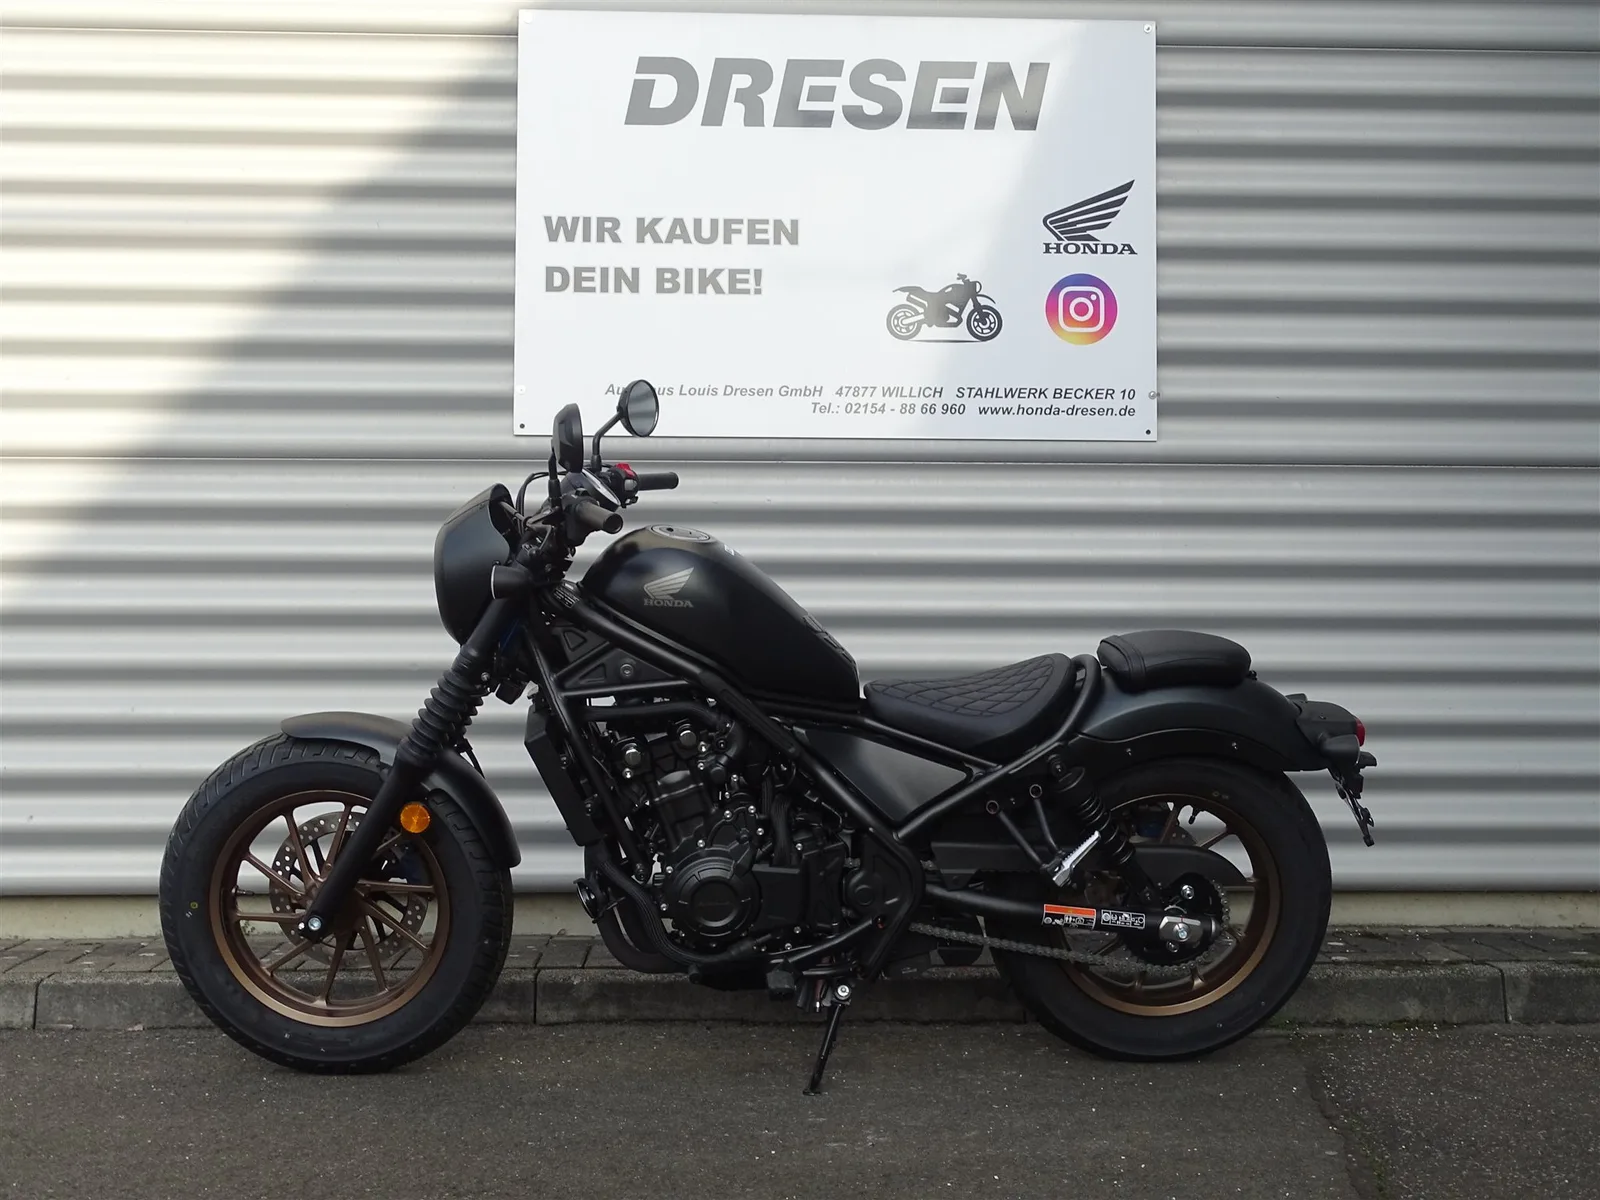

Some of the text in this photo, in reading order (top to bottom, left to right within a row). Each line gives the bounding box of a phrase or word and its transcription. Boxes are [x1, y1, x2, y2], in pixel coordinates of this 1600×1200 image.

[624, 56, 1050, 131] DRESEN
[544, 216, 799, 246] WIR KAUFEN
[1043, 242, 1138, 255] HONDA
[544, 266, 763, 295] DEIN BIKE!
[605, 384, 1136, 400] Auus Louis Dresen GmbH 47877 WILLICH STAHLWERK BECKER 10
[811, 402, 841, 415] Tel.:
[844, 402, 886, 415] 02154
[899, 403, 917, 416] 88
[920, 403, 938, 416] 66
[941, 403, 967, 416] 960
[978, 404, 1137, 417] www.honda-dresen.de
[643, 598, 694, 608] HONDA
